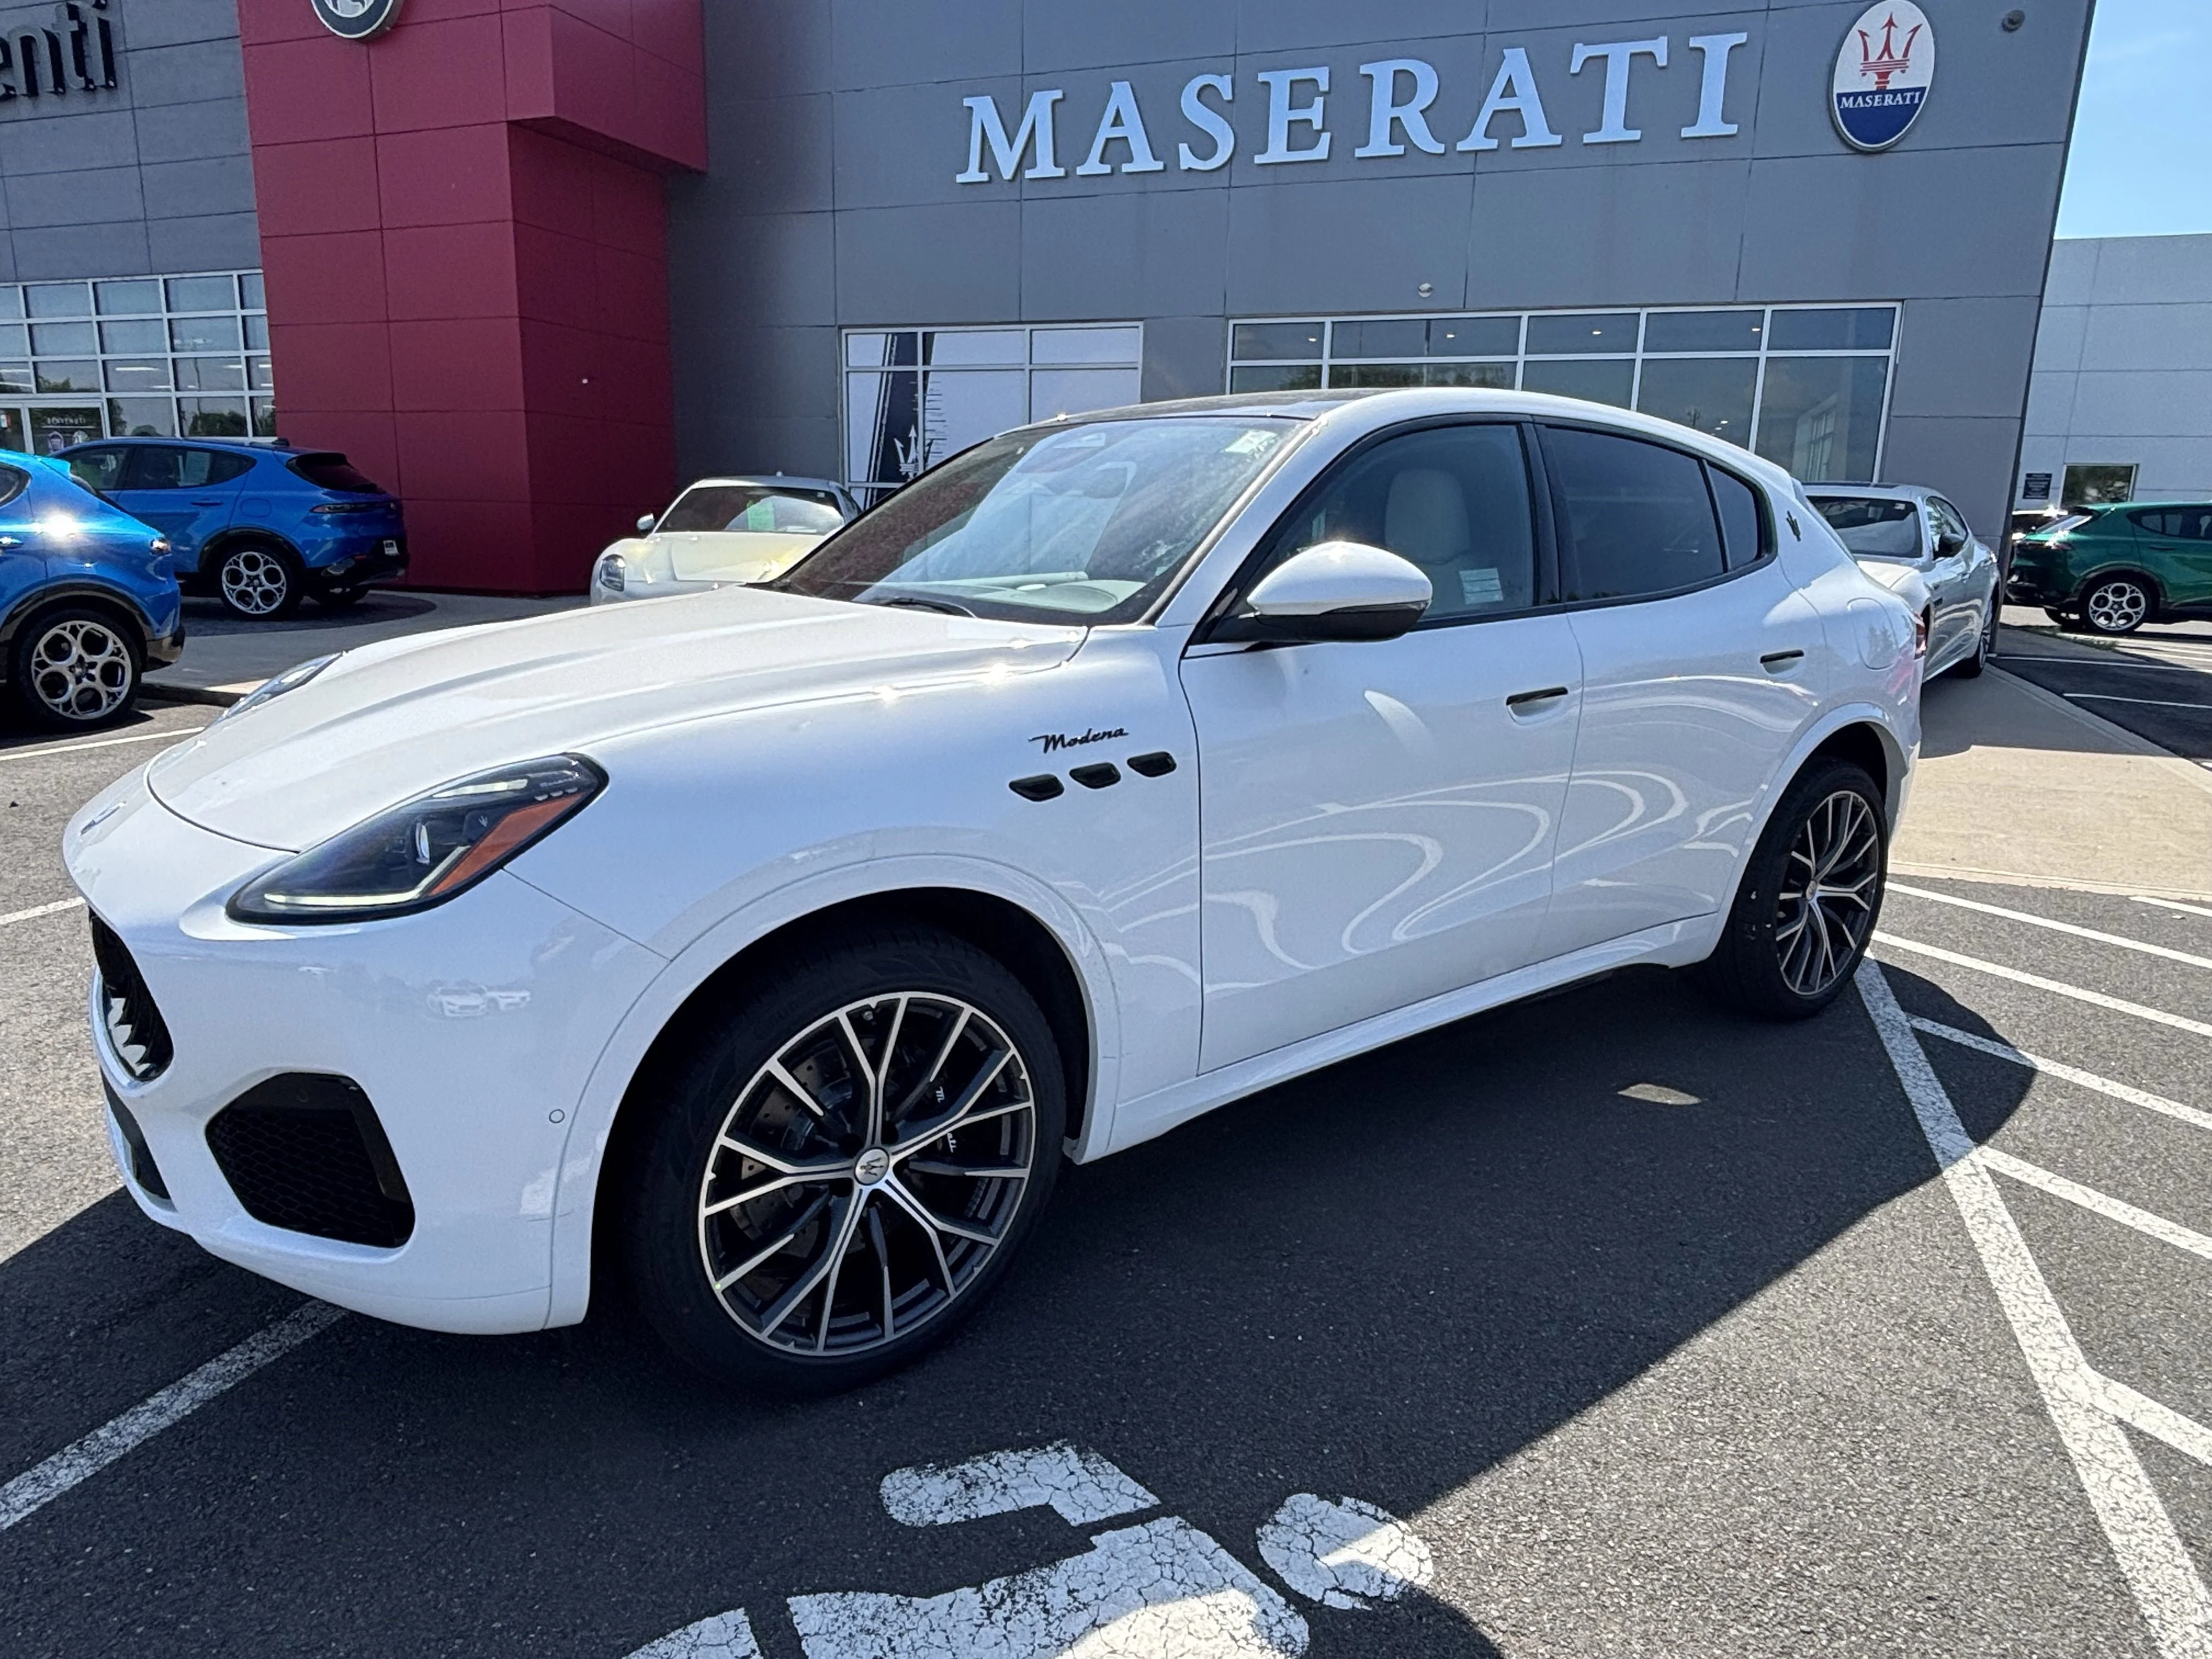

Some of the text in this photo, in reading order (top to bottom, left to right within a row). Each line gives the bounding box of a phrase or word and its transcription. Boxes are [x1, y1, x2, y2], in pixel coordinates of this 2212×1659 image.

[955, 31, 1748, 184] MASERATI
[1839, 91, 1921, 109] MASERATI
[1028, 727, 1129, 754] Modena
